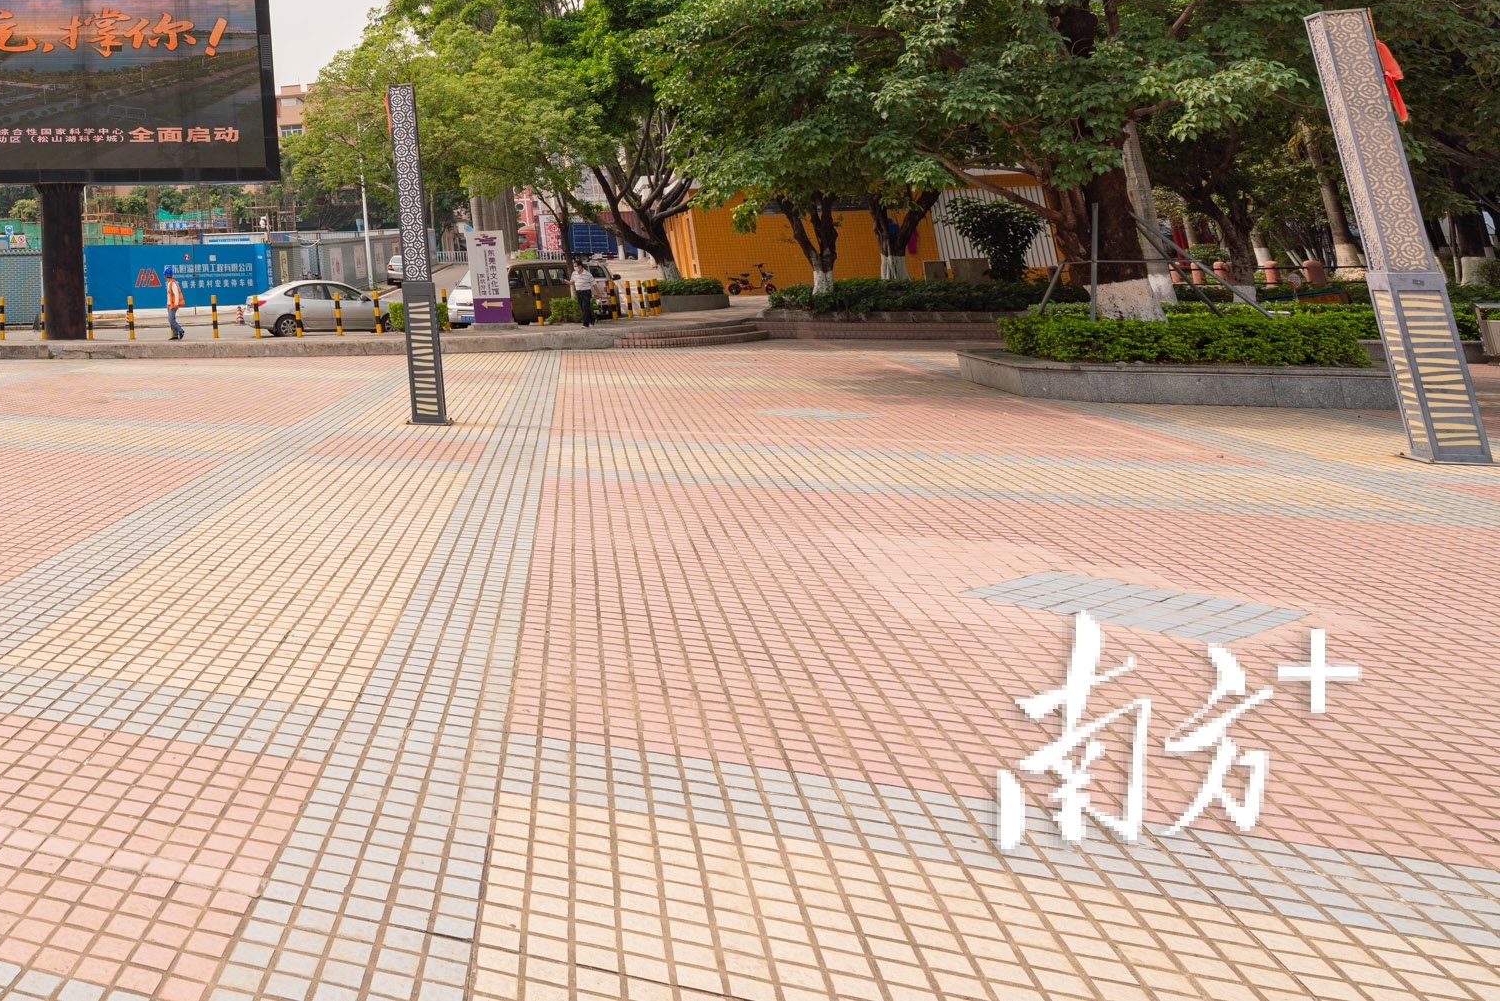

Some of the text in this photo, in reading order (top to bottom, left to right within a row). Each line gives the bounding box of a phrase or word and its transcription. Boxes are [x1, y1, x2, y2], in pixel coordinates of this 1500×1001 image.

[128, 126, 239, 143] 全面启动
[487, 249, 499, 296] 东莞市文化馆
